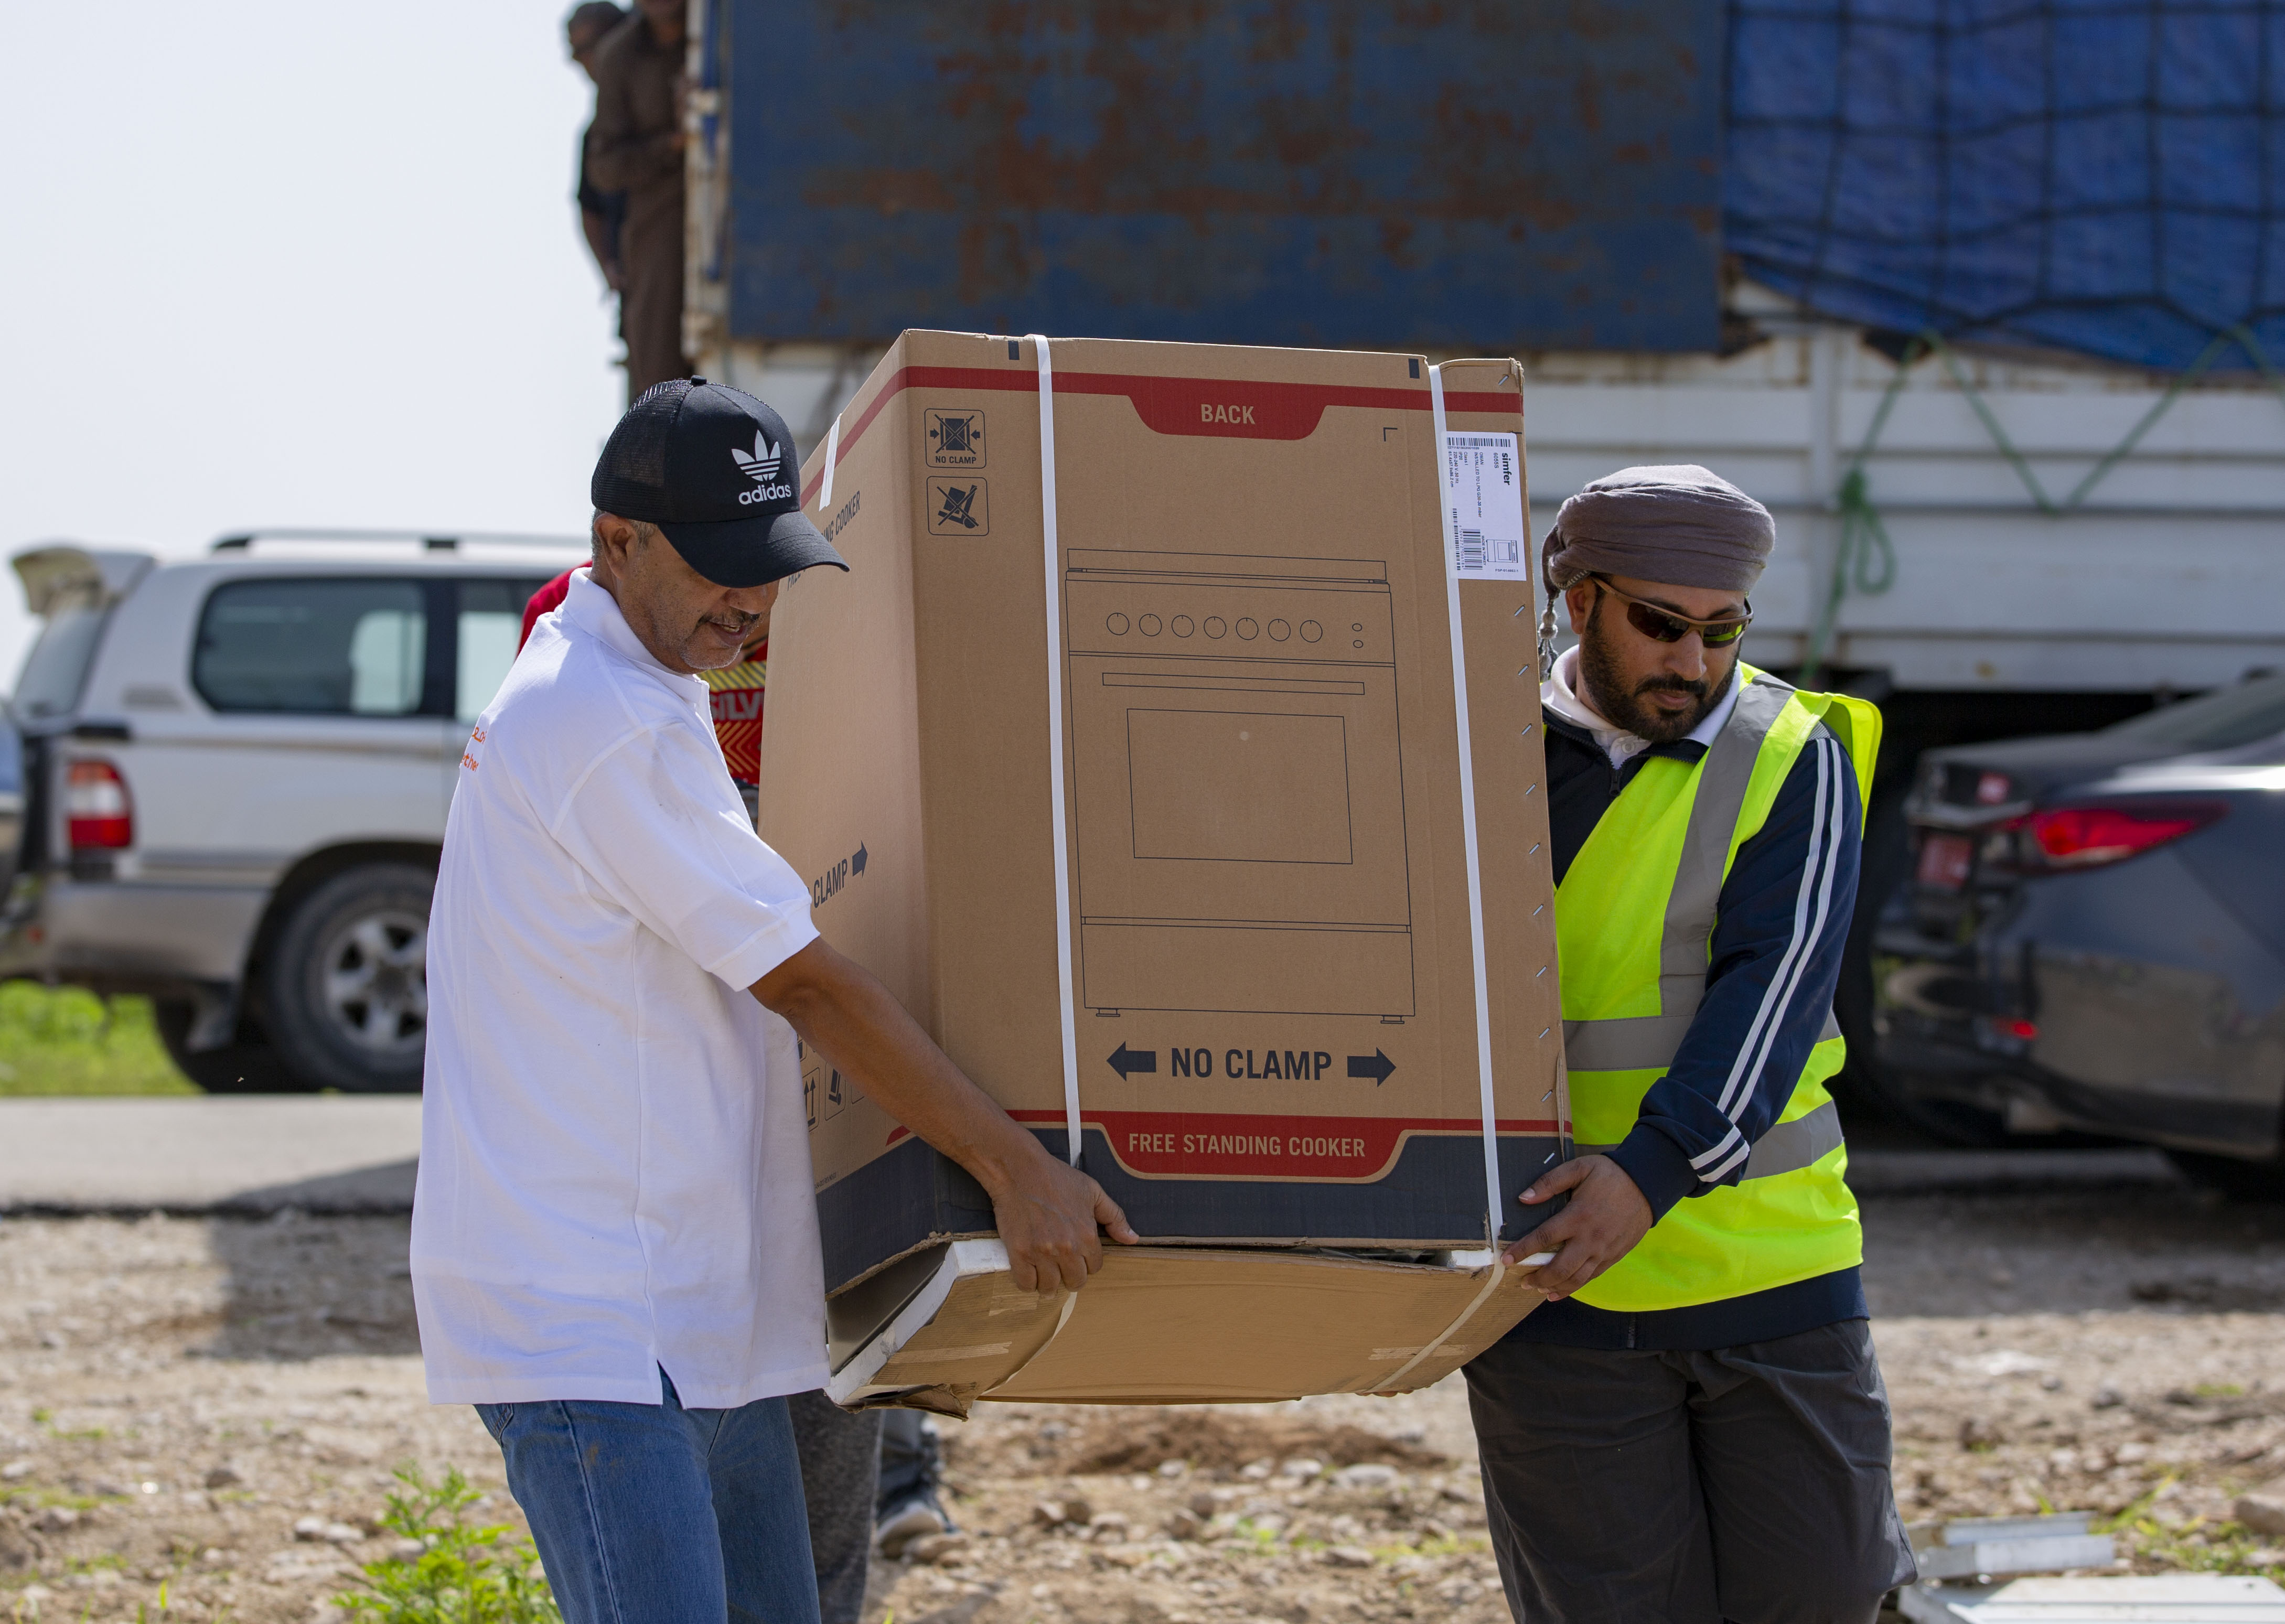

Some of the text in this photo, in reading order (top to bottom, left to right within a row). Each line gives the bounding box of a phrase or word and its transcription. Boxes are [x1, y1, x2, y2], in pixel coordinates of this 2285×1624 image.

[1201, 404, 1256, 424] BACK
[1502, 453, 1512, 486] simfer
[739, 483, 791, 505] adidas
[836, 490, 860, 535] COOKER
[710, 691, 765, 720] SILV
[813, 858, 848, 908] CLAMP
[1171, 1048, 1332, 1080] NO CLAMP
[1129, 1133, 1366, 1157] FREE STANDING COOKER
